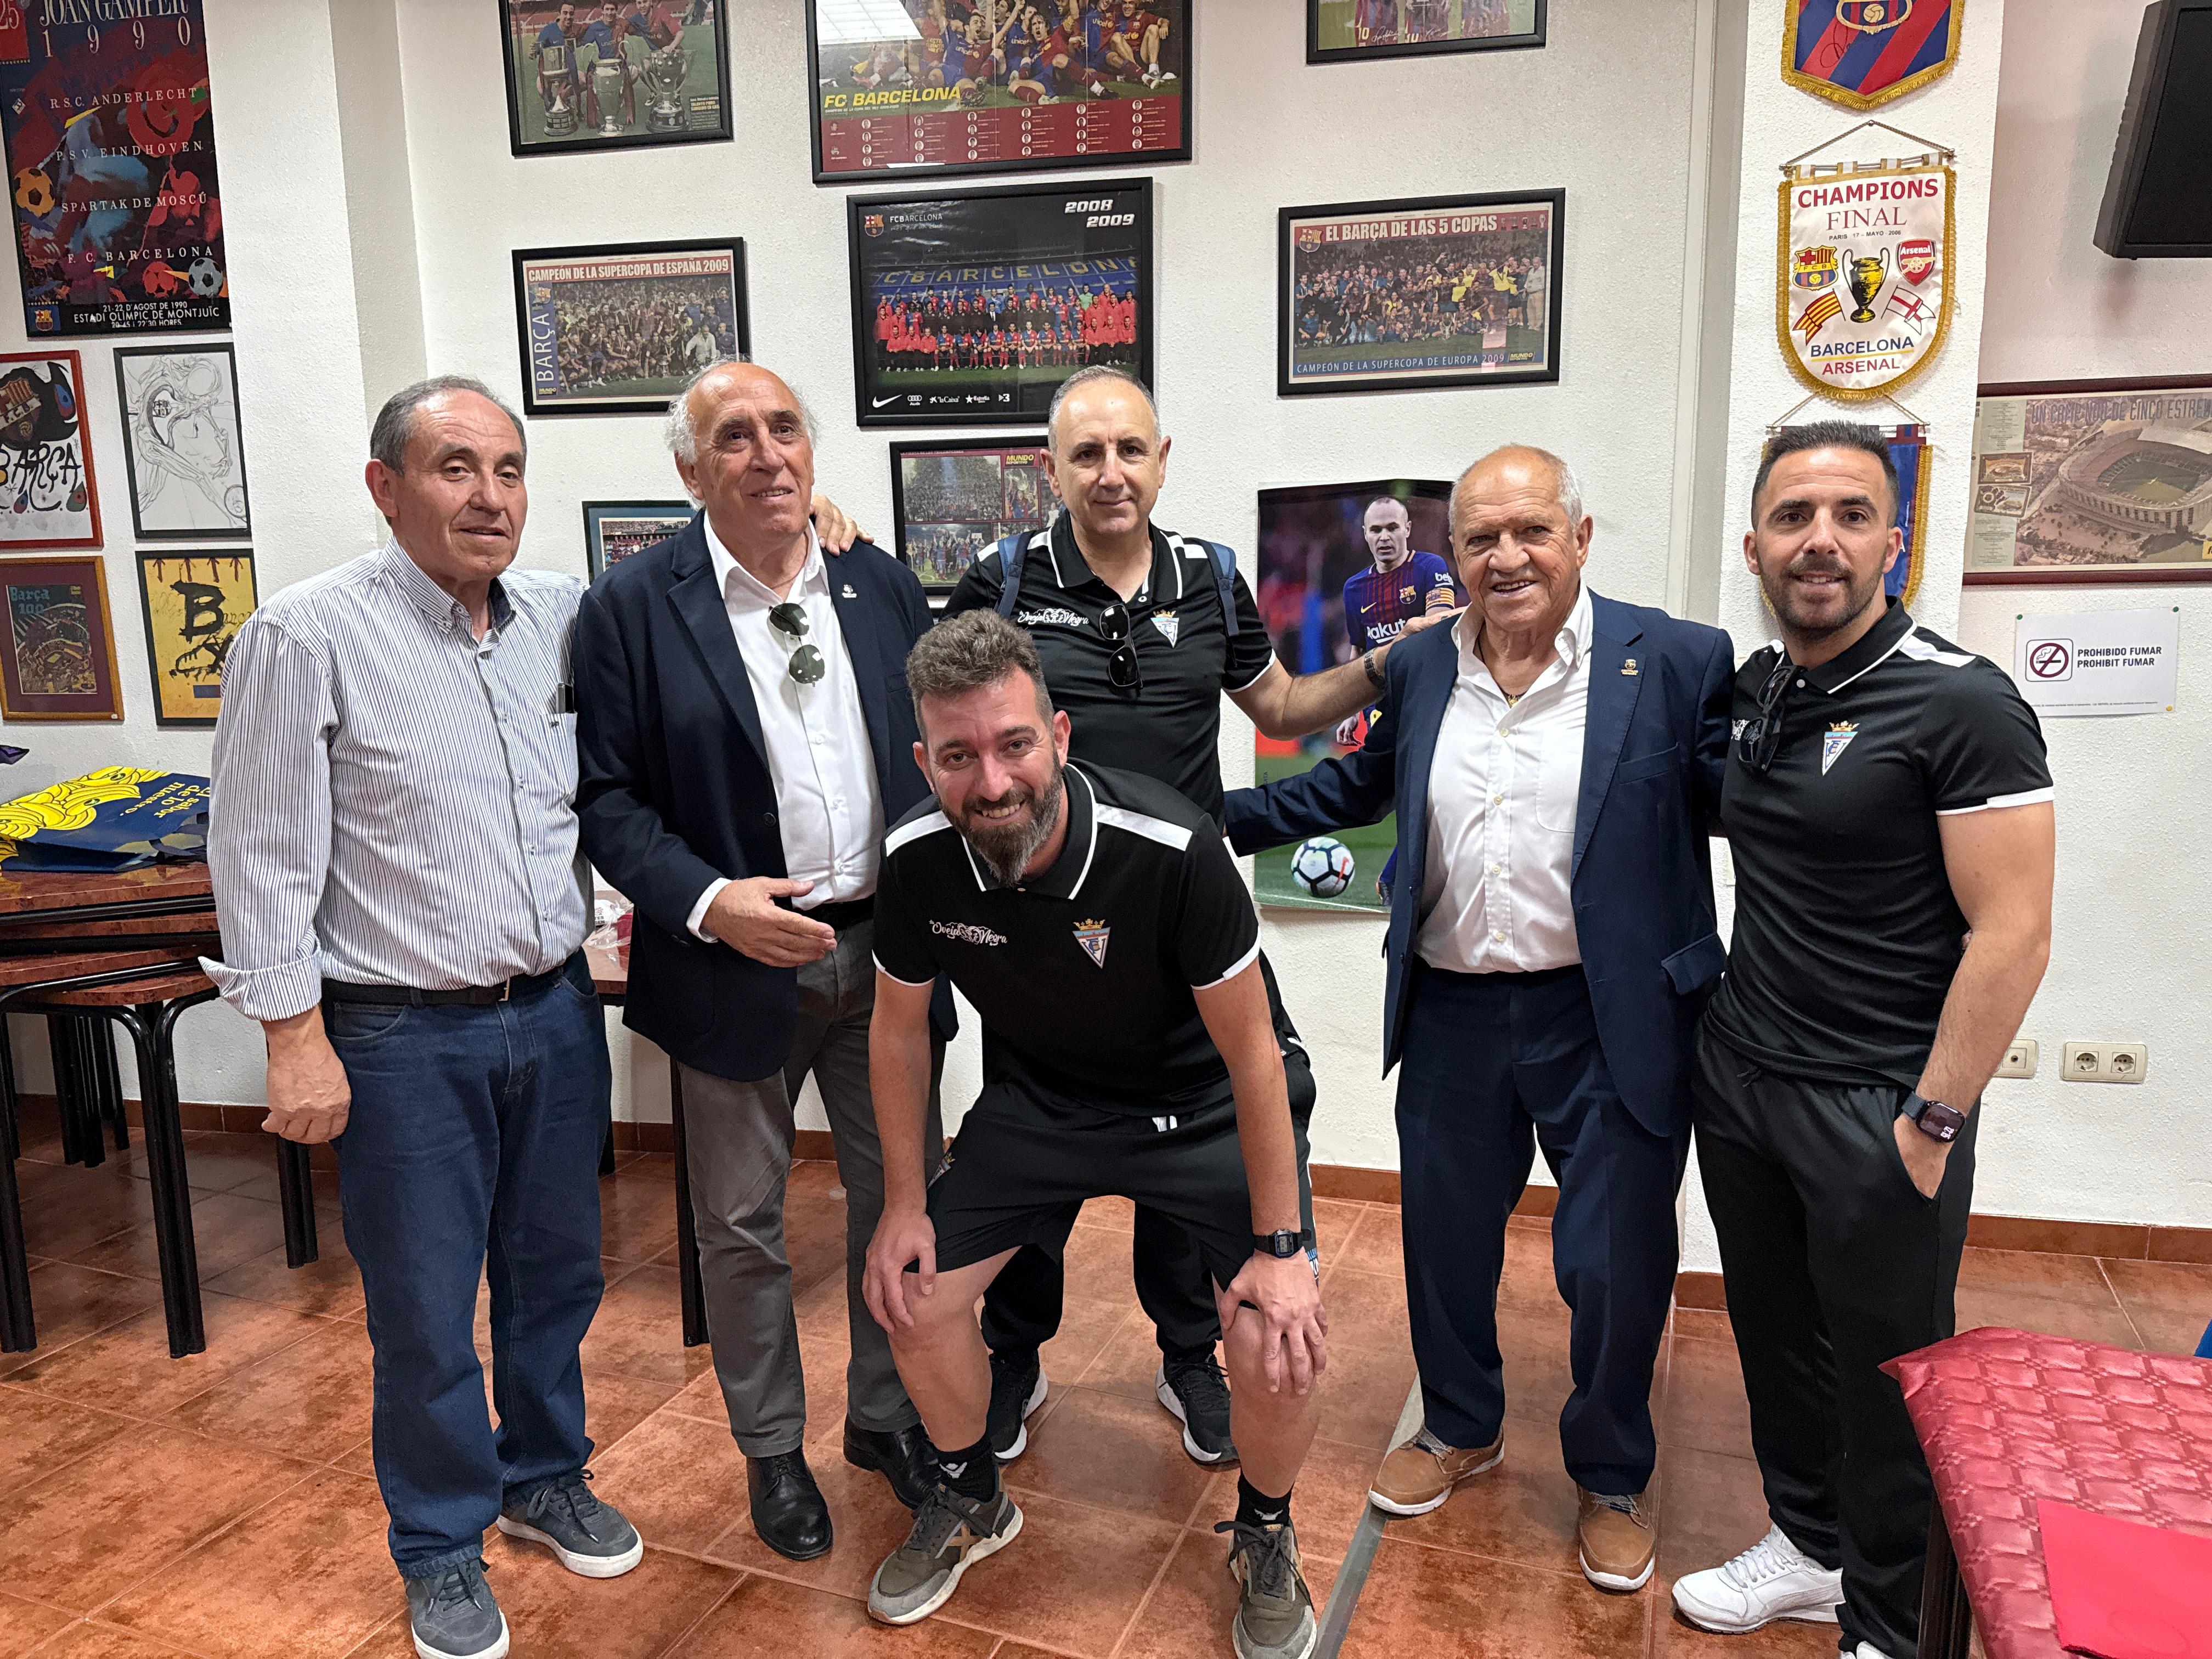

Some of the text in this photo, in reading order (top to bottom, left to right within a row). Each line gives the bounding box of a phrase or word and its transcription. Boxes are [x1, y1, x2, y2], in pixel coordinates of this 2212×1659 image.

[92, 87, 198, 106] ANDERLECHT
[825, 86, 961, 108] FC BARCELONA
[100, 141, 204, 158] EINDHOVEN
[61, 191, 207, 213] SPARTAK DE MOSCÚ
[1798, 179, 1939, 208] CHAMPIONS
[1065, 199, 1114, 214] 2008
[1086, 213, 1135, 228] 2009
[1826, 207, 1908, 231] FINAL
[1325, 215, 1497, 242] EL BARÇA DE LAS 5 COPAS
[105, 246, 213, 262] BARCELONA
[1900, 246, 1931, 256] Arsenal
[528, 258, 729, 281] CAMPEÓN DE LA SUPERCOPA DE ESPAÑA 2009
[74, 313, 105, 324] ESTADI
[152, 310, 164, 320] DE
[167, 306, 220, 318] MONTJUÏC
[159, 302, 169, 310] DE
[531, 313, 556, 382] BARÇA
[1811, 336, 1914, 357] BARCELONA
[1297, 354, 1504, 374] CAMPEÓN DE LA SUPERCOPA DE EUROPA 2009
[1822, 358, 1900, 376] ARSENAL
[9, 587, 50, 602] Barça
[18, 603, 44, 615] 100
[1367, 618, 1406, 640] Rakut
[2077, 646, 2162, 657] PROHIBIDO FUMAR
[2077, 657, 2155, 668] PROHIBIT FUMAR
[154, 797, 199, 818] sabor
[980, 929, 1008, 946] Negra
